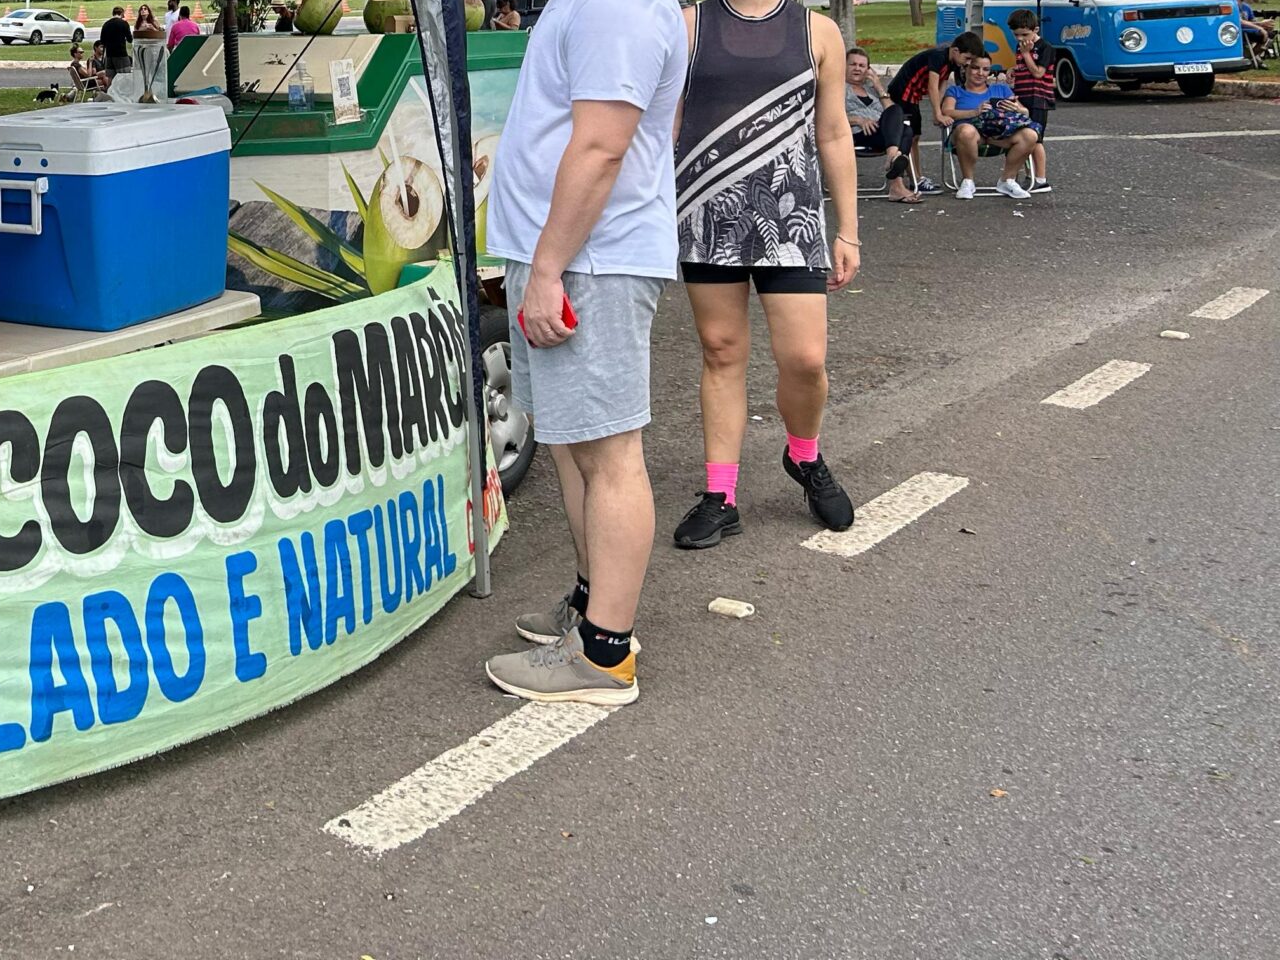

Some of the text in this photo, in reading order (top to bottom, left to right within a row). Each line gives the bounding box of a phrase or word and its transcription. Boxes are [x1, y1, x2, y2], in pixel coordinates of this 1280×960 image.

[263, 354, 340, 498] do
[332, 286, 469, 476] MARCÃ
[226, 551, 267, 683] E
[277, 474, 458, 657] NATURAL
